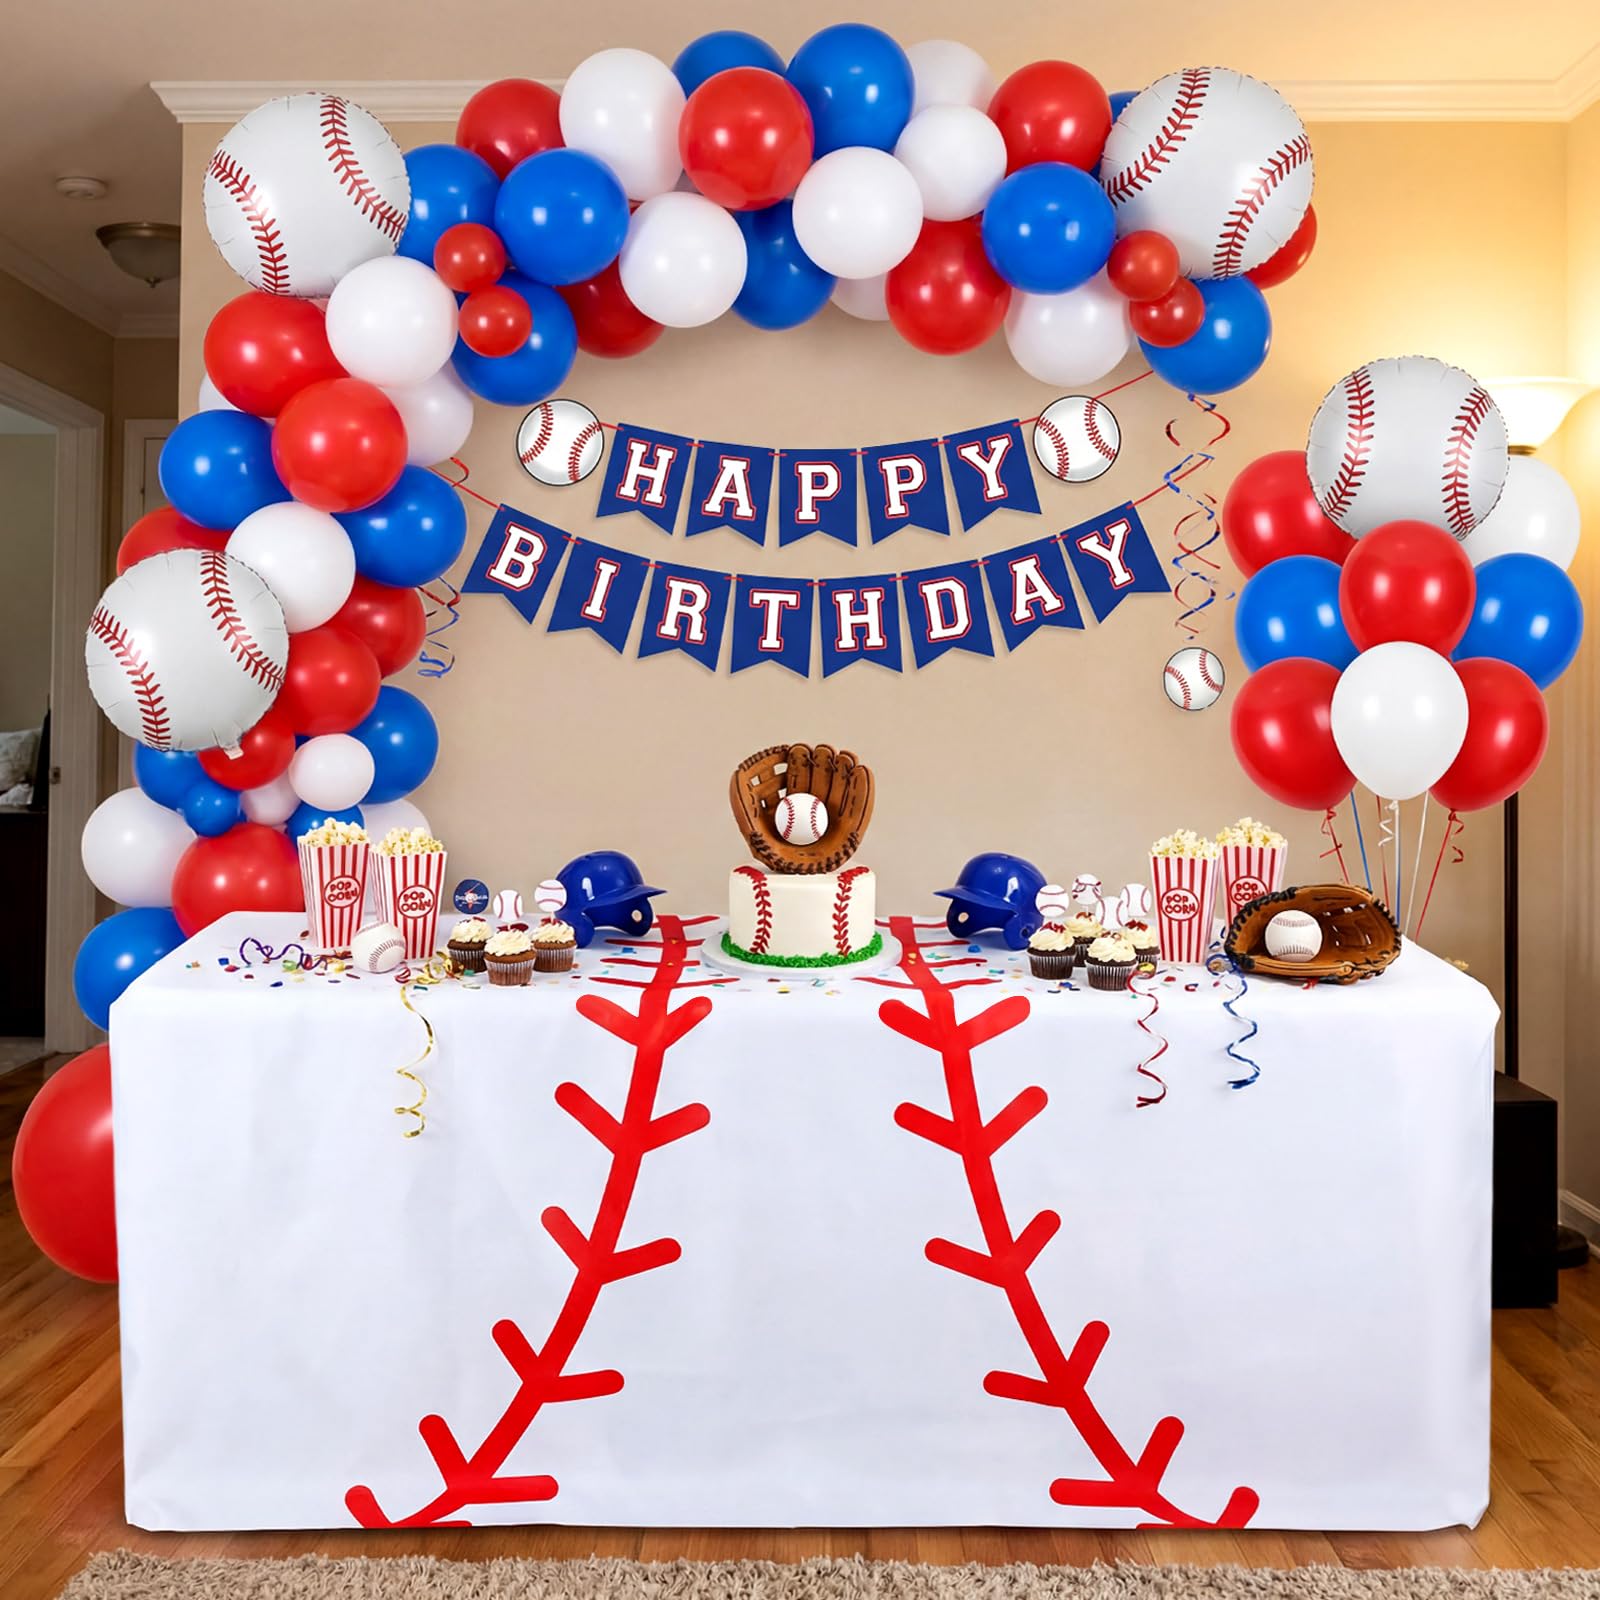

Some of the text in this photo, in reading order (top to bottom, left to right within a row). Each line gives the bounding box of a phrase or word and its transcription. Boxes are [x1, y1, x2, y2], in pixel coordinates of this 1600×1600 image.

[618, 433, 1013, 524] HAPPY
[486, 518, 1135, 652] BIRTHDAY
[330, 881, 352, 893] POP
[1236, 882, 1258, 892] POP
[403, 891, 425, 902] POP
[1166, 894, 1189, 904] POP
[1165, 902, 1196, 915] CORN
